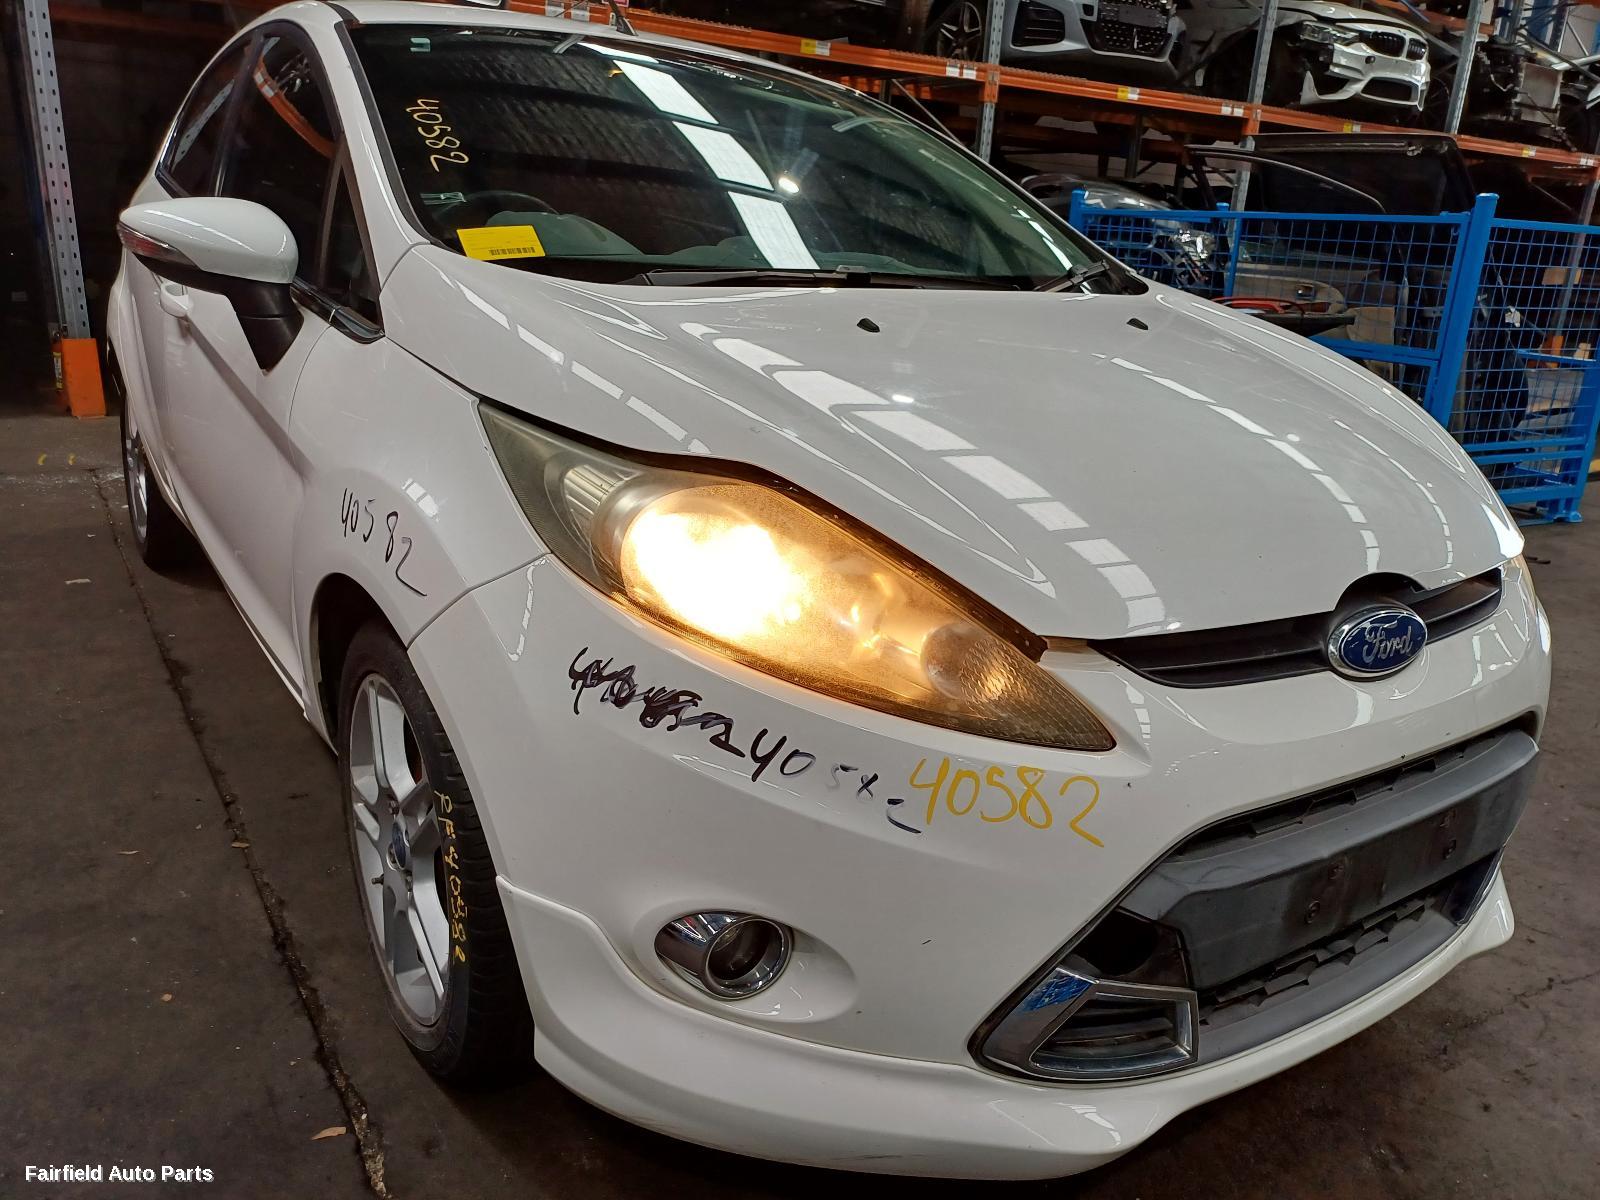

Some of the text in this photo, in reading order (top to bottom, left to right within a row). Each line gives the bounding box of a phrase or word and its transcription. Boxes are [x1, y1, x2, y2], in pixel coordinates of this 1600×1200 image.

[406, 98, 469, 172] 40582
[341, 487, 428, 597] 40582
[1362, 620, 1413, 664] Ford
[909, 756, 1105, 848] 40582
